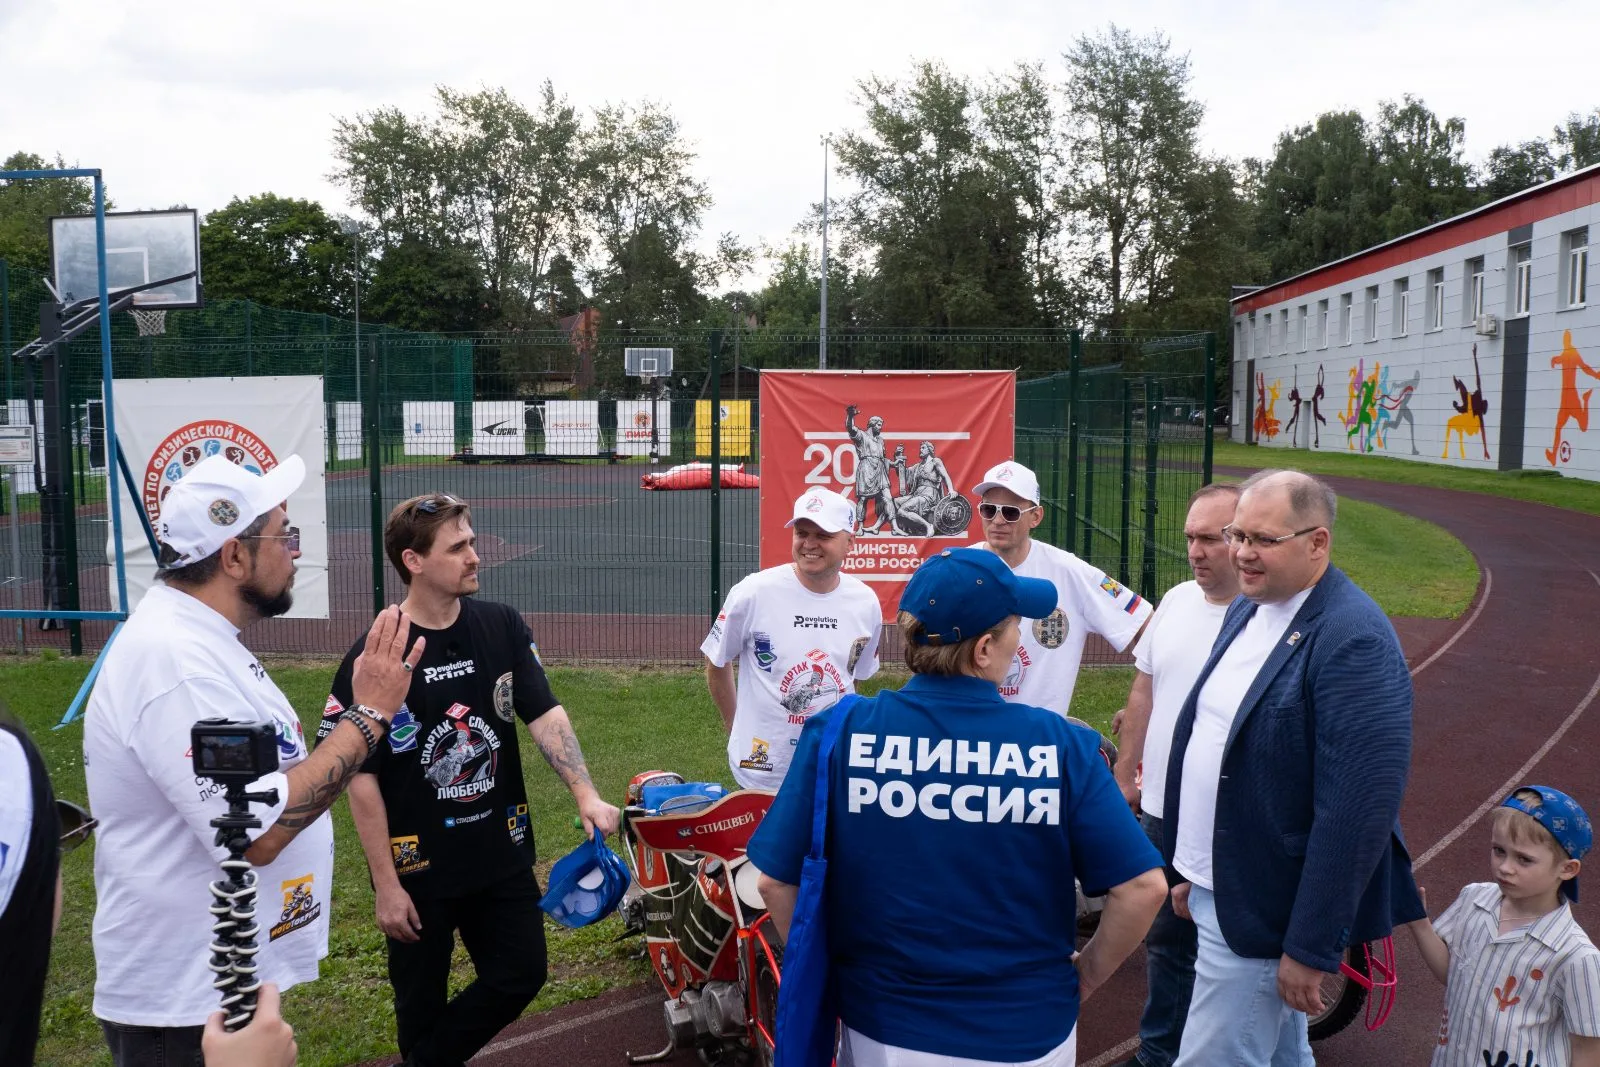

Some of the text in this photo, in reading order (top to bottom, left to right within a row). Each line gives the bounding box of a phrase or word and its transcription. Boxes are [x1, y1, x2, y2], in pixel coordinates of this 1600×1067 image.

[146, 472, 160, 491] ПО
[153, 424, 233, 470] ФИЗИЧЕСКОЙ
[803, 443, 859, 485] 20
[848, 543, 917, 556] ДИНСТВА
[1017, 645, 1032, 667] ДВЕЙ
[779, 661, 809, 693] СПАРТАК
[420, 719, 453, 765] СПАРТАК
[848, 733, 1060, 779] ЕДИНАЯ
[437, 776, 495, 800] ЛЮБЕРЦЫ
[848, 777, 1060, 825] РОССИЯ
[694, 811, 756, 835] СПИДВЕЙ
